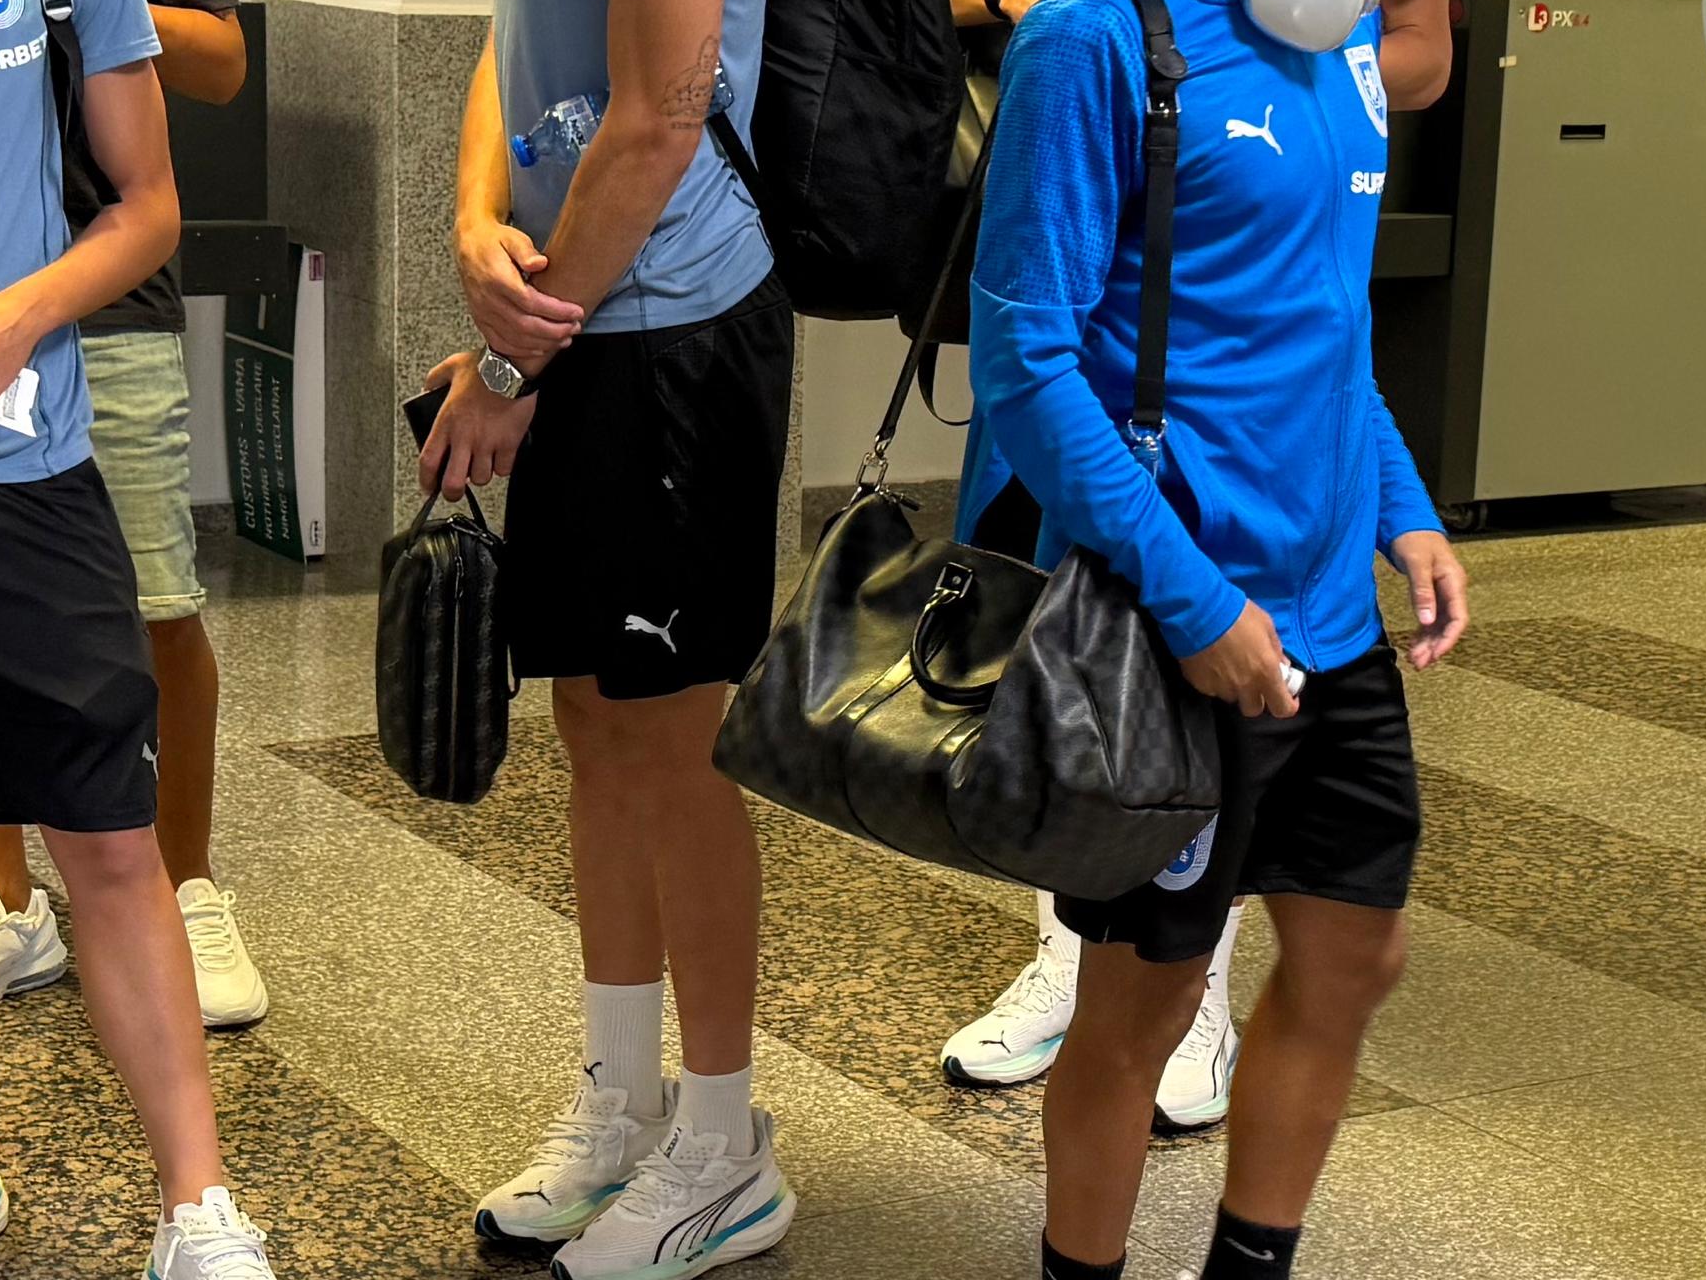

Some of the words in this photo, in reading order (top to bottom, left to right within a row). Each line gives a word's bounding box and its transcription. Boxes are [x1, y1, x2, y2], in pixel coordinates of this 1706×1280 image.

[233, 357, 246, 414] VAMA
[256, 439, 267, 459] TO
[236, 436, 257, 529] CUSTOMS
[259, 467, 274, 540] NOTHING
